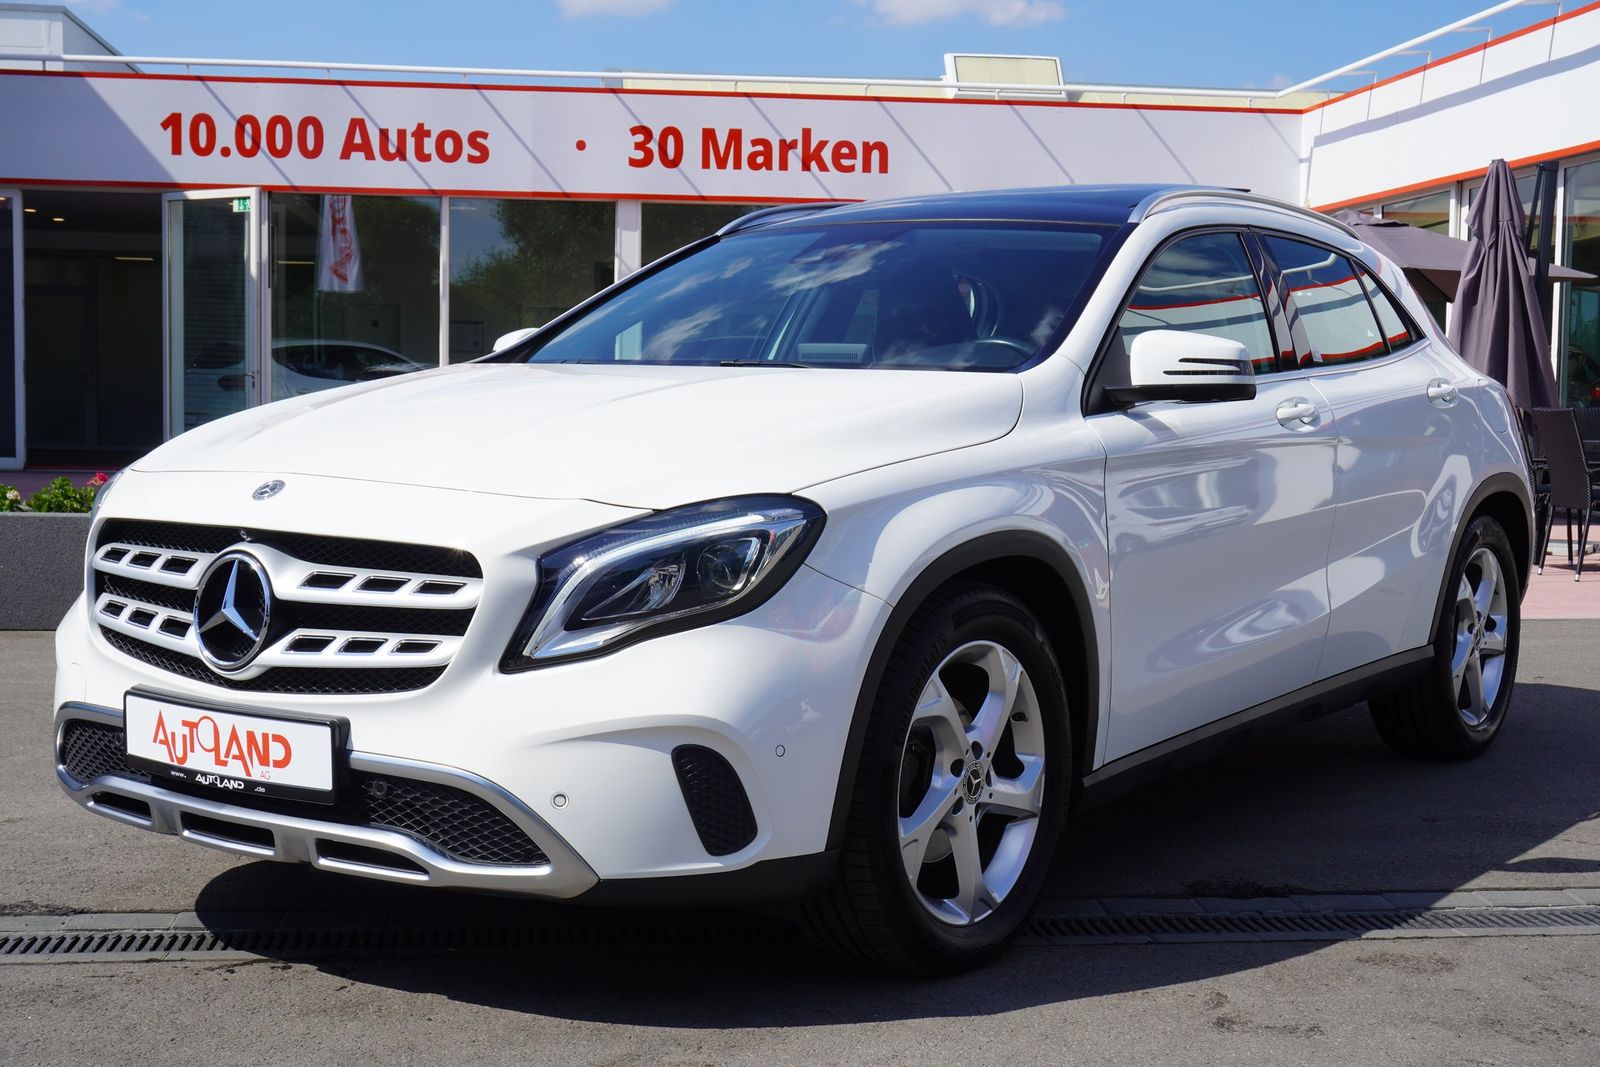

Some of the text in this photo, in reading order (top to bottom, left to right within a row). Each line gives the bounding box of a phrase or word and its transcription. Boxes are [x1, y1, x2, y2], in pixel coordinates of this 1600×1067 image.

[160, 112, 889, 174] 10.000 Autos 30 Marken
[260, 770, 271, 780] AG
